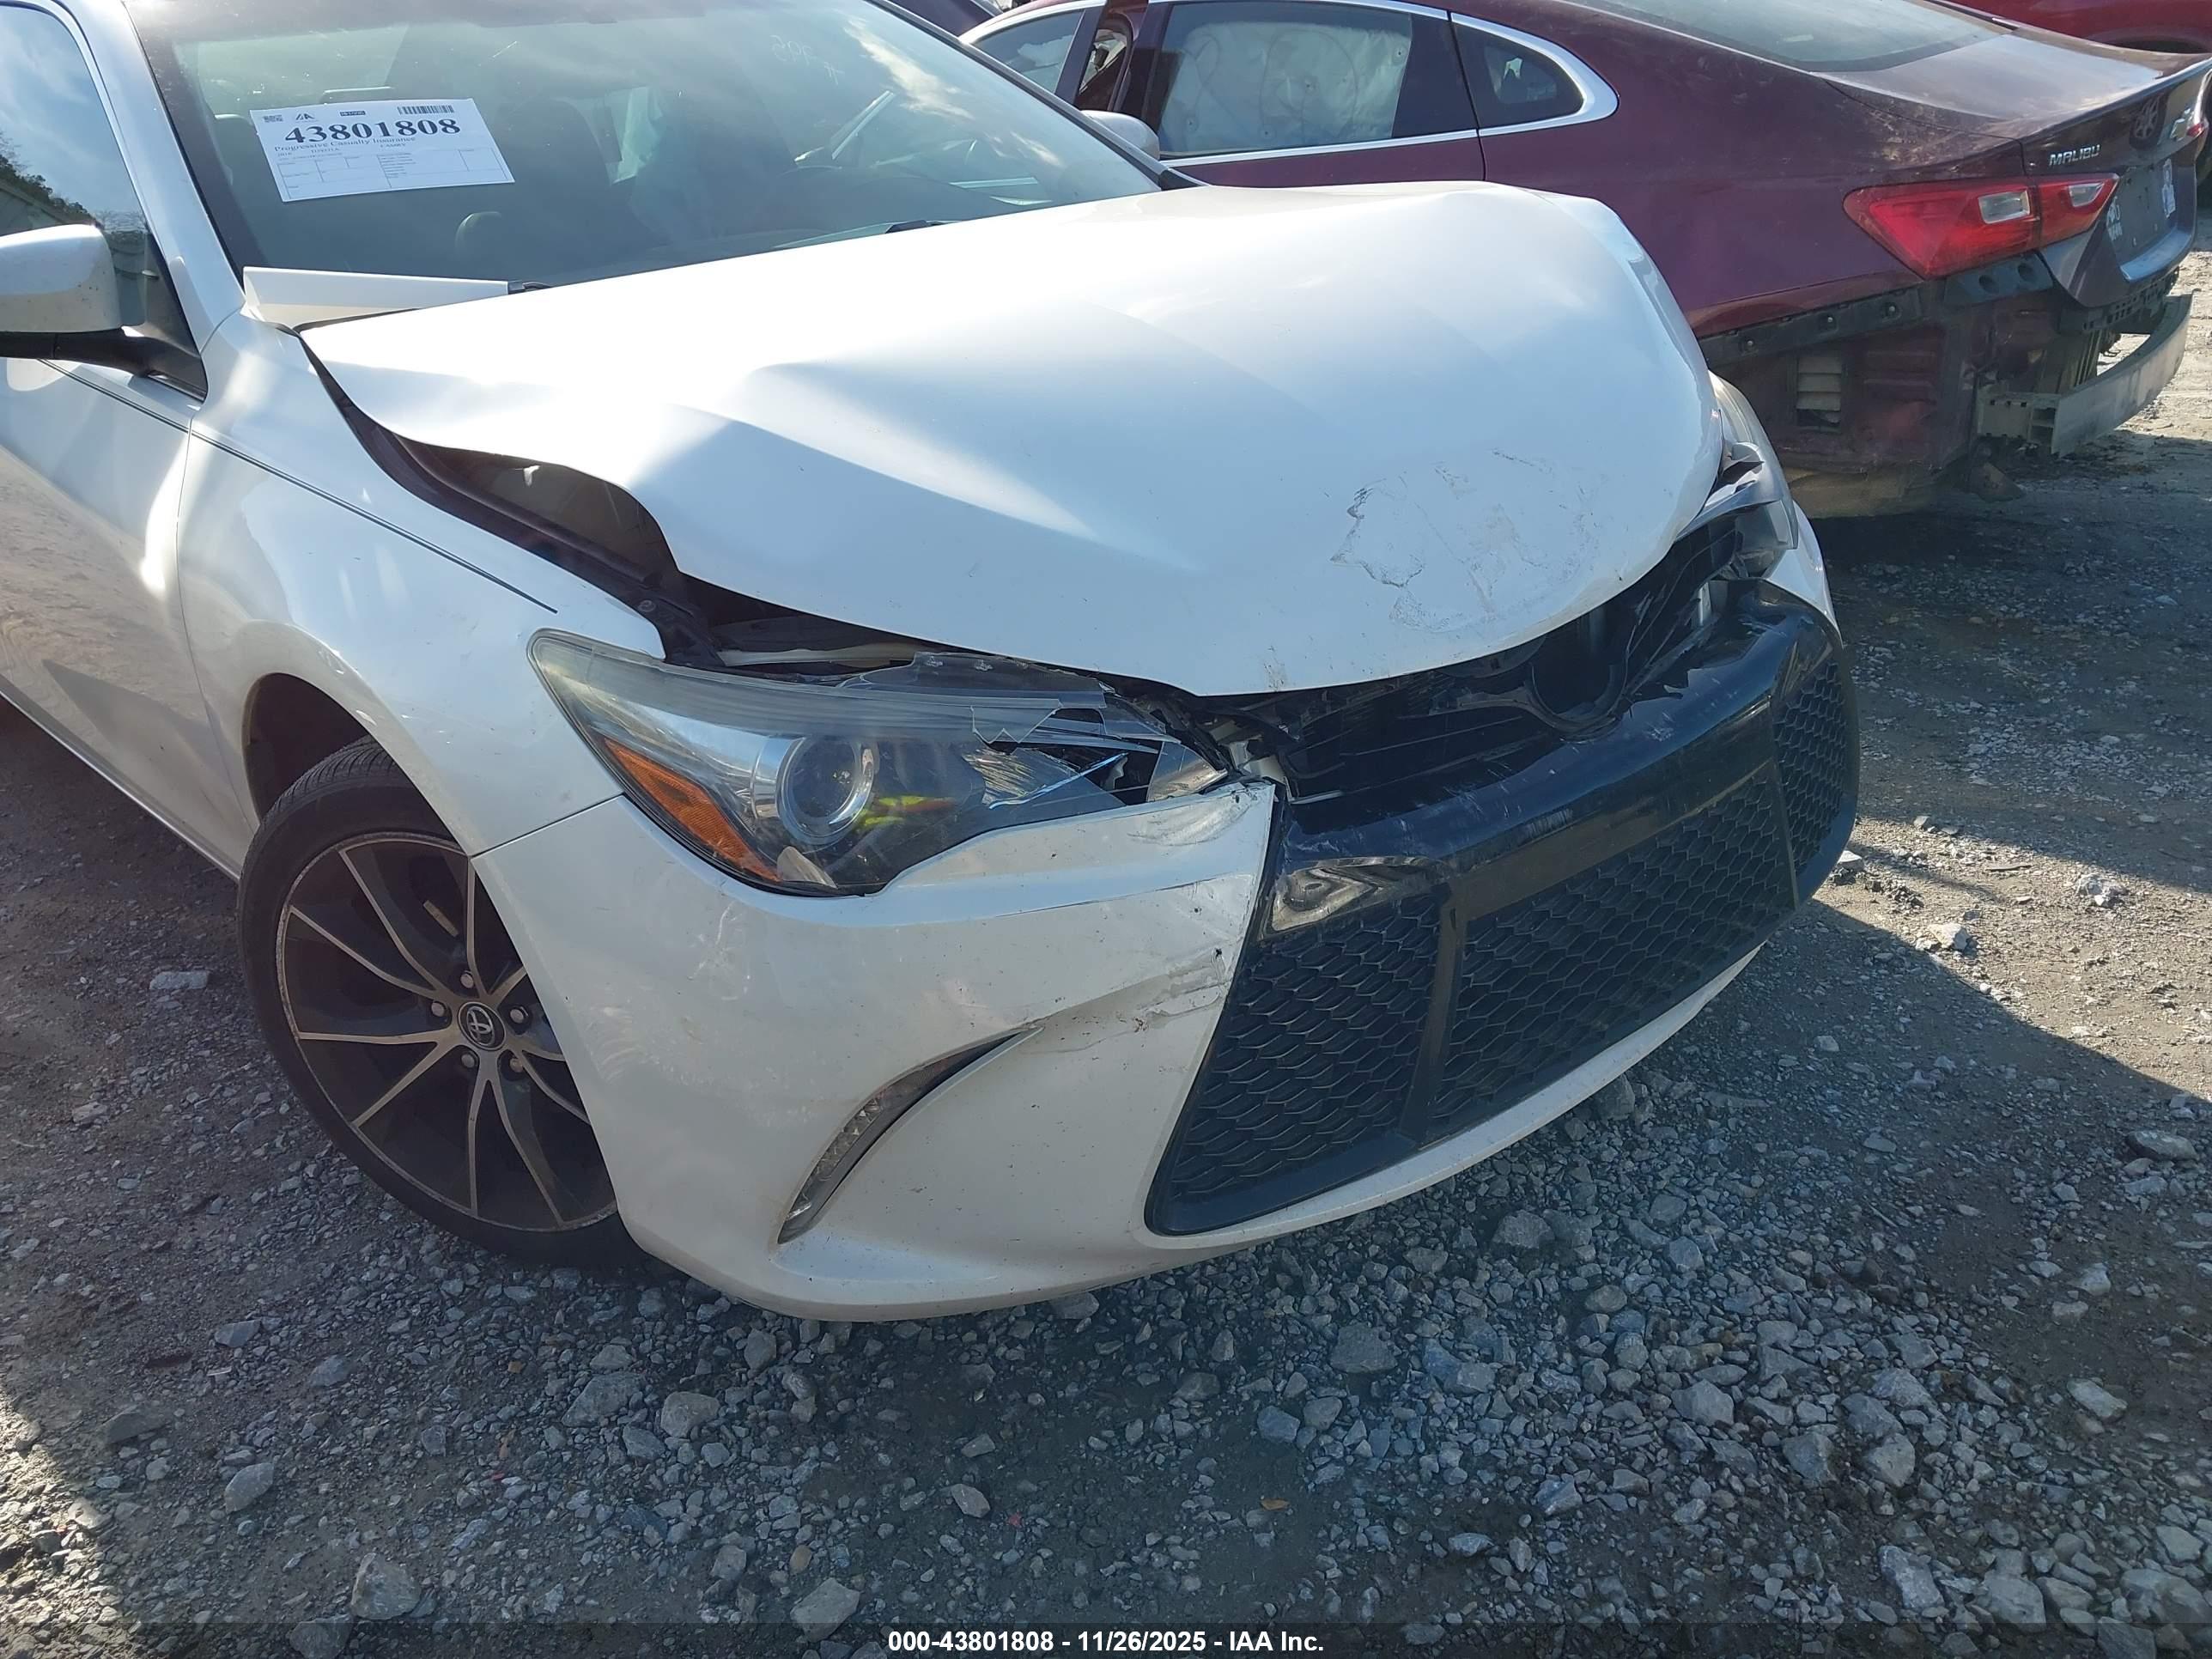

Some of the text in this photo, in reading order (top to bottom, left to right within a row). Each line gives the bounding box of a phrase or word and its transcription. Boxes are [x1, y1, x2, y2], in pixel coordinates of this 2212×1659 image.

[285, 118, 460, 143] 43801808
[274, 142, 328, 152] Progressive
[331, 138, 370, 147] Casualty
[2050, 144, 2100, 166] MALIBU
